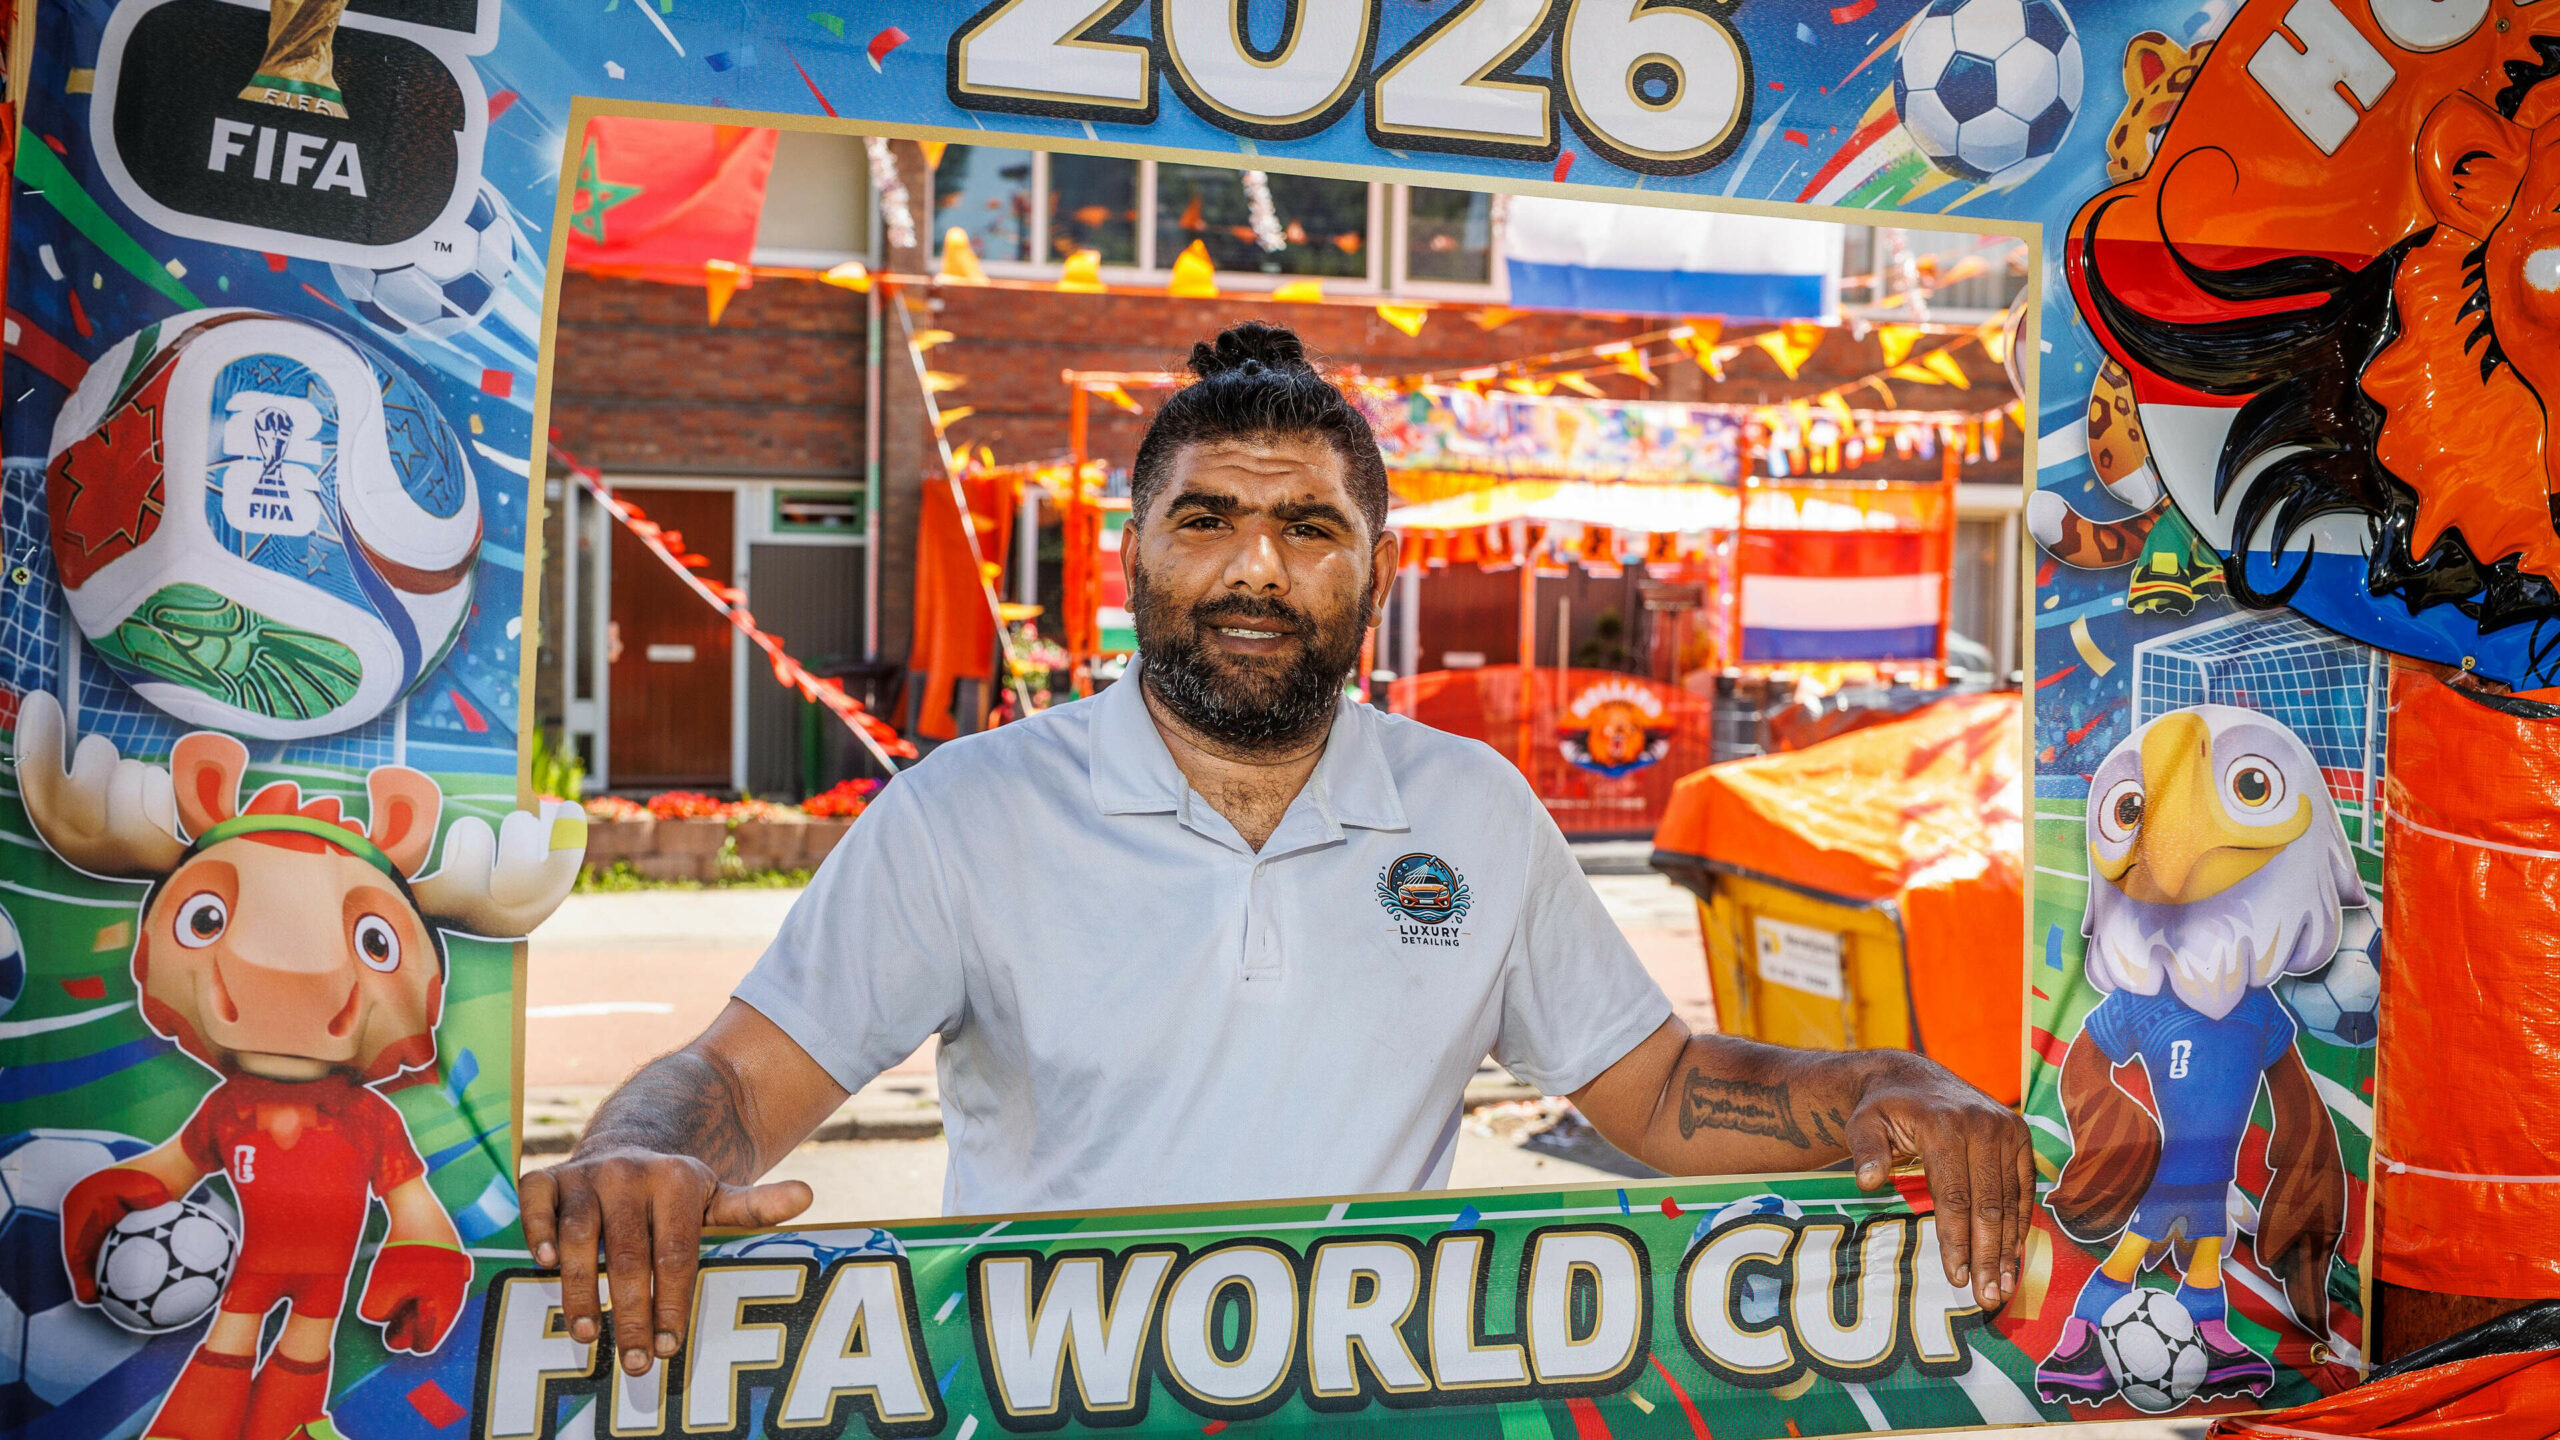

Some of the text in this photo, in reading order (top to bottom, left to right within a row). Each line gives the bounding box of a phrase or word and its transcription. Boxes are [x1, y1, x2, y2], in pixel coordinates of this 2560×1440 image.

[207, 117, 368, 198] FIFA
[433, 240, 452, 253] TM
[249, 502, 294, 521] FIFA
[1400, 925, 1459, 938] LUXURY
[1401, 936, 1460, 947] DETAILING
[979, 1230, 1643, 1417] WORLD
